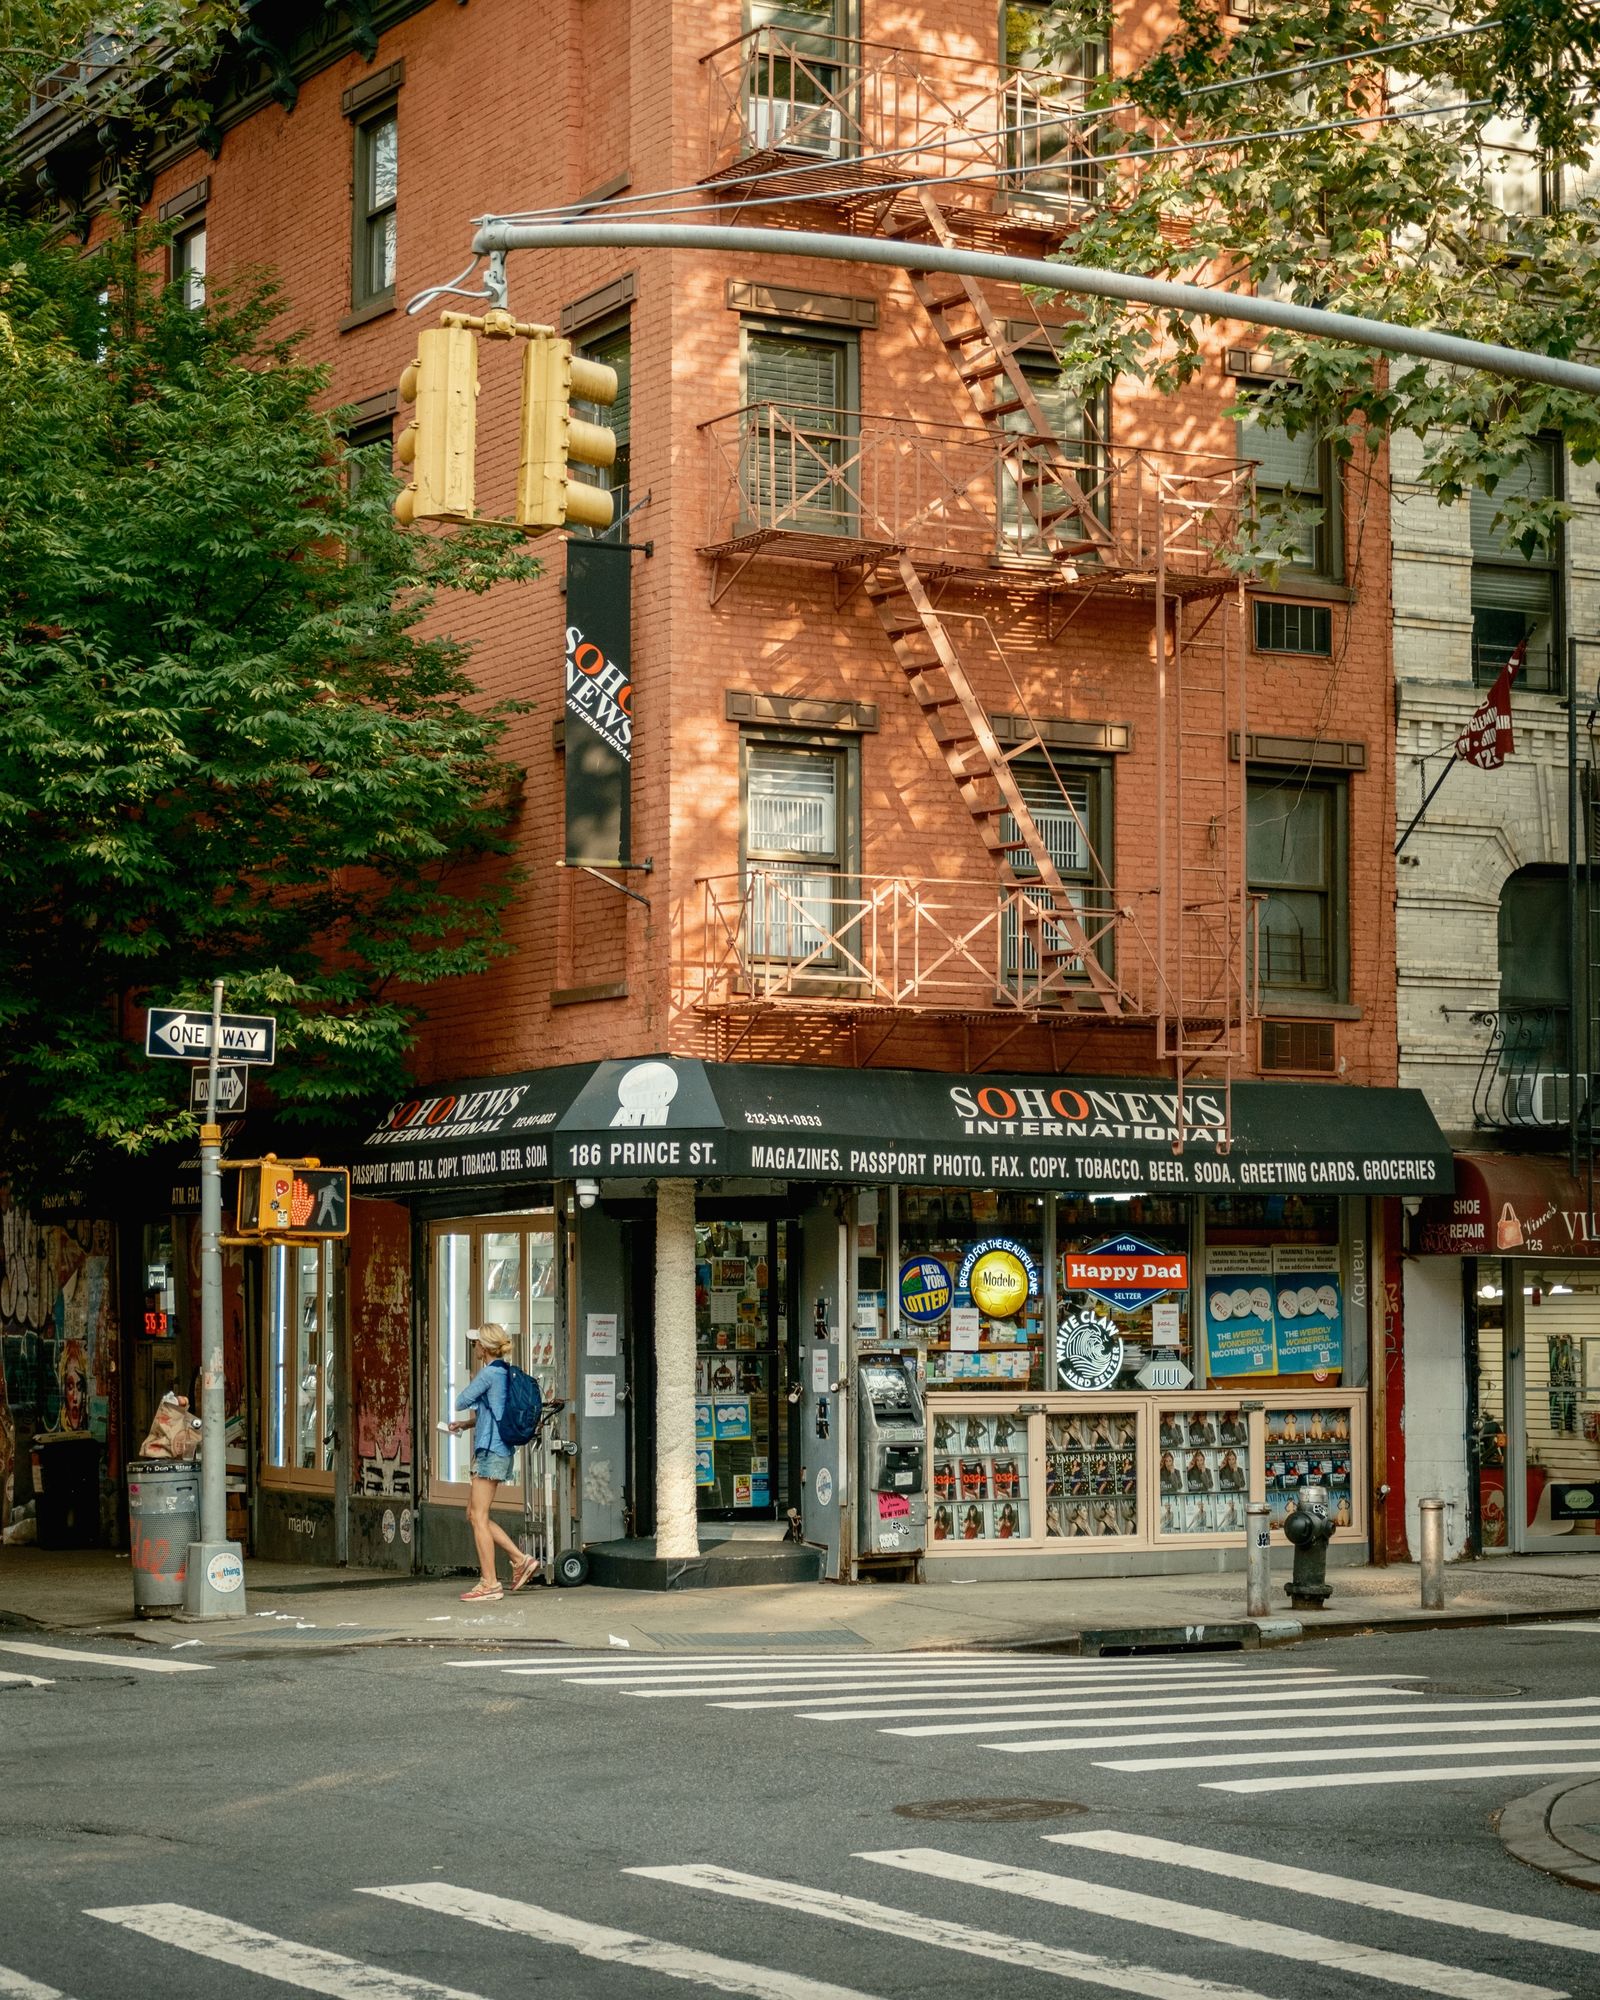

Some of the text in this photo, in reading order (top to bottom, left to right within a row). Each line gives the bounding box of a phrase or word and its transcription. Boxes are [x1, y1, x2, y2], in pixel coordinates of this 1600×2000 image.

[566, 658, 631, 745] NEWS
[566, 698, 632, 762] INTERNATIONAL
[169, 1025, 258, 1049] ONE WAY
[199, 1080, 238, 1098] ON WAY
[608, 1105, 669, 1127] ATM
[745, 1112, 822, 1127] 212-941-0833
[364, 1118, 505, 1145] INTERNATIONAL
[965, 1121, 1235, 1143] INTERNATIONAL
[569, 1142, 717, 1167] 186 PRINCE ST.
[352, 1162, 389, 1185] PASSPORT
[390, 1160, 417, 1181] PHOTO.
[418, 1159, 435, 1180] FAX.
[438, 1157, 459, 1179] COPY.
[462, 1153, 498, 1177] TOBACCO.
[500, 1149, 523, 1171] BEER.
[525, 1145, 548, 1168] SODA
[751, 1146, 1436, 1184] MAGAZINES. PASSPORT PHOTO. FAX. COPY. TOBACCO. BEER. SODA. GREETING CARDS. GROCERIES
[1453, 1200, 1481, 1215] SHOE
[1450, 1223, 1485, 1239] REPAIR
[1117, 1244, 1136, 1252] HARD
[1525, 1239, 1543, 1251] 125
[921, 1264, 940, 1275] NEW
[959, 1239, 1039, 1296] BREWED FOR THE BEAUTIFUL GAME
[1071, 1263, 1182, 1281] Happy Dad
[924, 1275, 947, 1290] YORK
[983, 1271, 1016, 1288] Modelo
[903, 1288, 949, 1313] LOTTERY
[1114, 1292, 1141, 1300] SELTZER
[1252, 1300, 1268, 1308] VELO
[1319, 1298, 1335, 1306] VELO
[1056, 1315, 1080, 1363] WHITE
[1080, 1310, 1119, 1337] CLAW
[1217, 1328, 1265, 1340] THE WEIRDLY
[1211, 1343, 1273, 1358] NICOTINE POUCH
[1218, 1338, 1265, 1348] WONDERFUL
[1279, 1341, 1340, 1356] NICOTINE POUCH
[1066, 1369, 1091, 1387] HARD
[1094, 1346, 1120, 1386] SELTZER
[963, 1474, 987, 1484] 032c
[995, 1473, 1019, 1482] 032c
[880, 1508, 908, 1519] NEW YORK
[288, 1514, 317, 1539] marby
